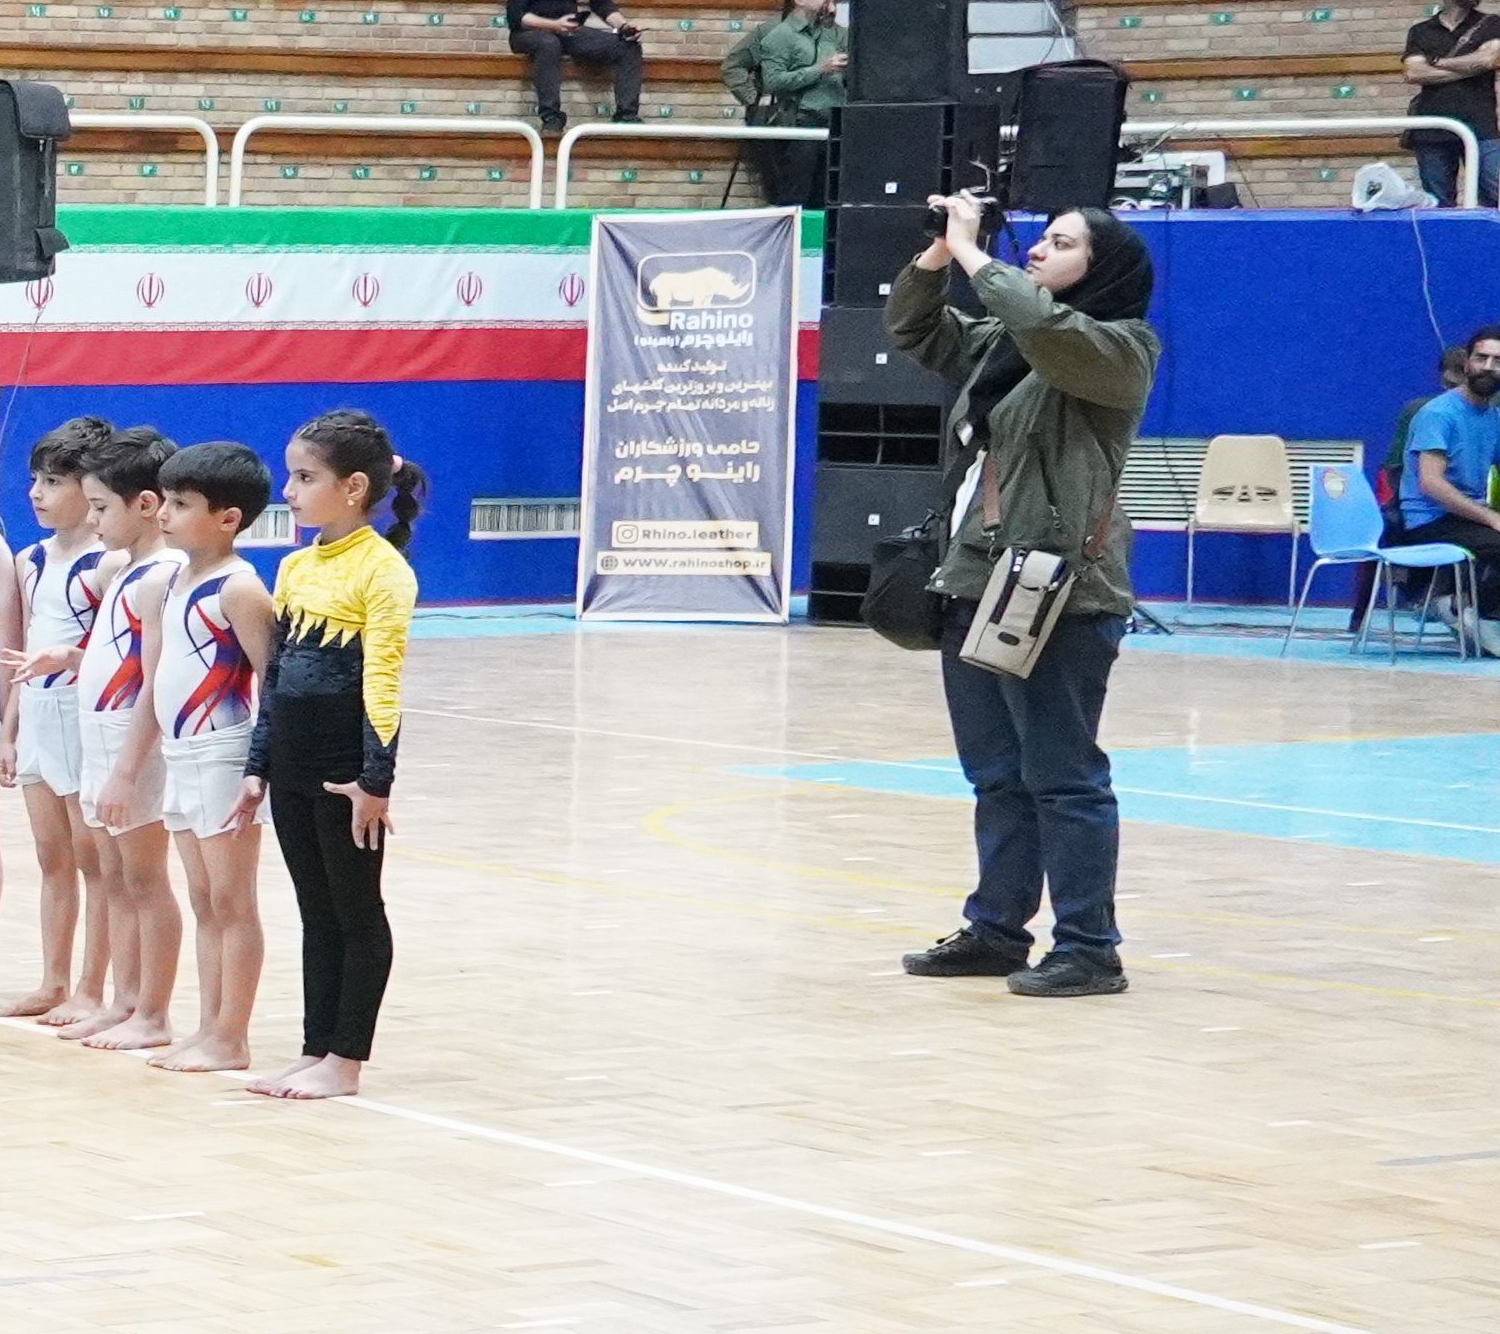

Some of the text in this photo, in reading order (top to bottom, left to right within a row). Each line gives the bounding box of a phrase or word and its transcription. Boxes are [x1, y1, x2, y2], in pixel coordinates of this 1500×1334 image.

[670, 310, 754, 331] Rahino
[615, 436, 761, 459] حامی ورزشکاران
[613, 460, 761, 487] راینو چرم
[642, 528, 752, 541] Rhino.leather
